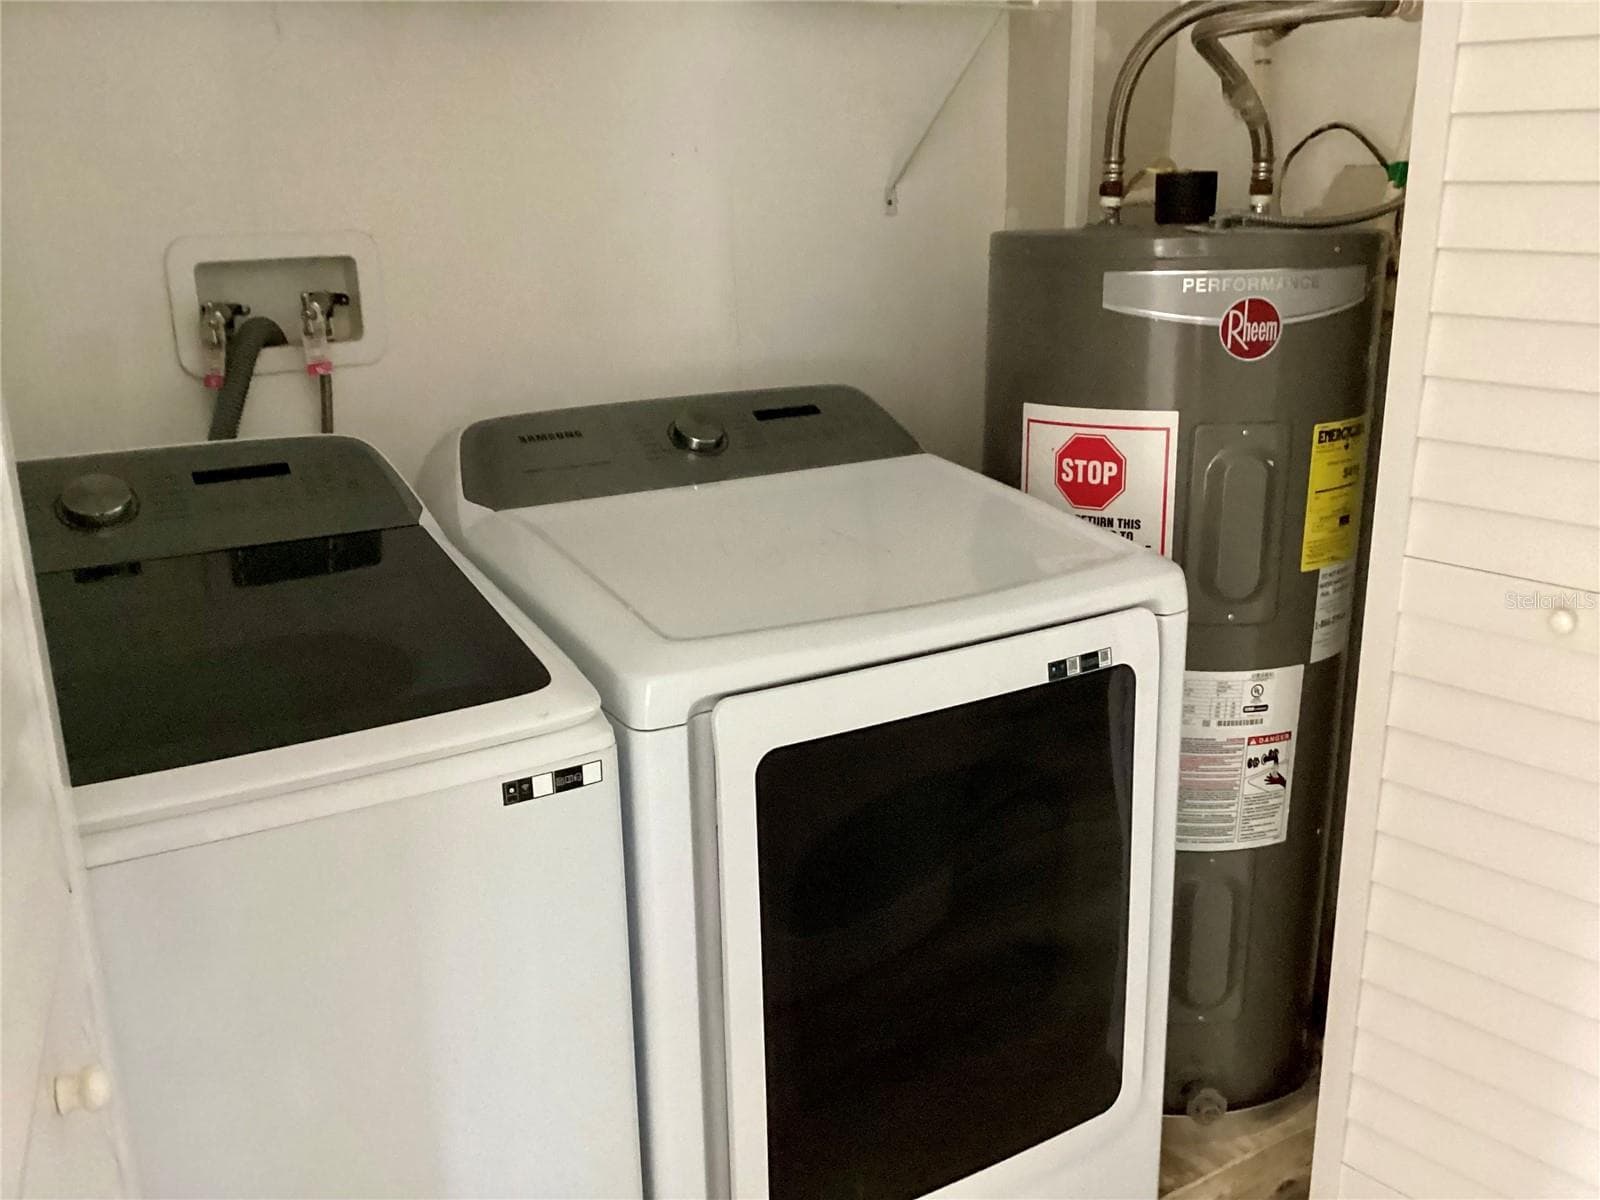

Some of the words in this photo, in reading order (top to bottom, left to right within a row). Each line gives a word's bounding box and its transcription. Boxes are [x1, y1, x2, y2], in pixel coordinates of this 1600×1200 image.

[1182, 274, 1321, 294] PERFORMANCE
[1227, 299, 1278, 350] Rheem
[518, 430, 584, 443] SAMSUNG
[1061, 458, 1118, 486] STOP
[1075, 514, 1114, 529] TURN
[1117, 518, 1142, 530] THIS
[1258, 733, 1290, 745] DANGER
